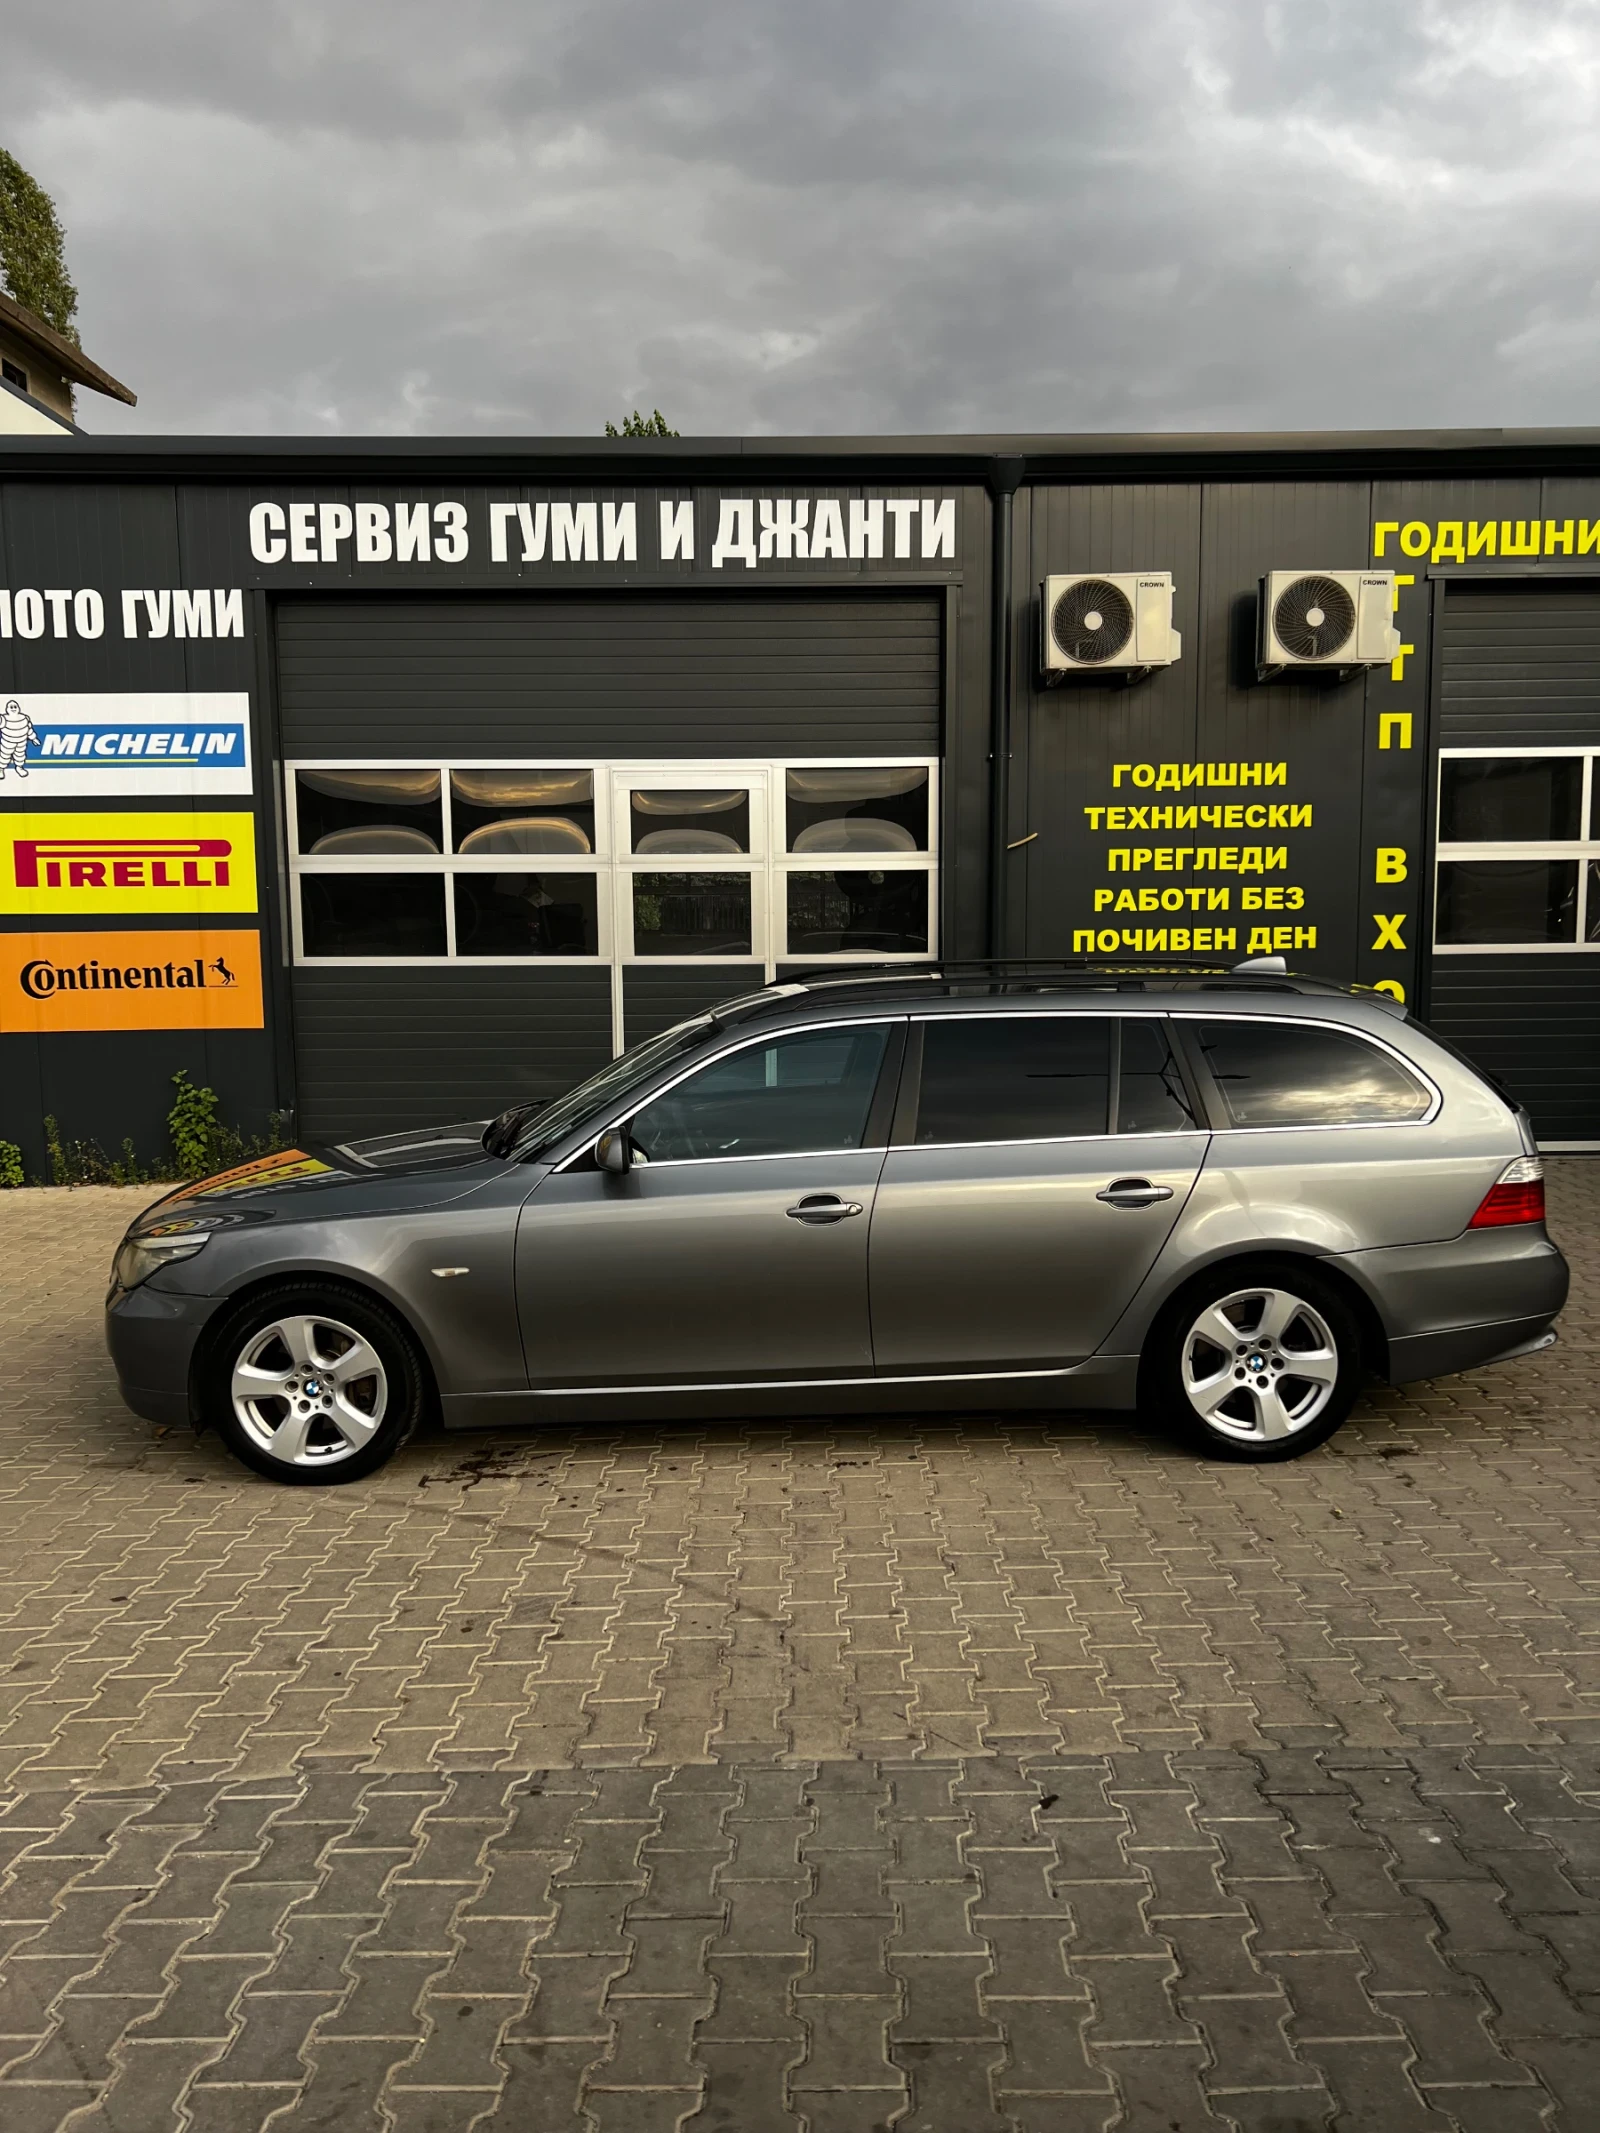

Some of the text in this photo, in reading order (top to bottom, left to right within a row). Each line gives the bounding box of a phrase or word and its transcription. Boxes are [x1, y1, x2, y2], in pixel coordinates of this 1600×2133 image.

[249, 498, 956, 569] СЕРВИЗ ГУМИ И ДЖАНТИ
[1373, 519, 1600, 564] ГОДИШНИ
[121, 588, 245, 639] ГУМИ
[40, 732, 237, 756] MICHELIN
[1112, 762, 1288, 792] ГОДИШНИ
[1083, 804, 1313, 830] ТЕХНИЧЕСКИ
[13, 839, 232, 888] PIRELLI
[1108, 846, 1288, 875] ПРЕГЛЕДИ
[1094, 886, 1305, 912] РАБОТИ БЕЗ
[1073, 926, 1317, 955] ПОЧИВЕН ДЕН
[20, 957, 207, 1000] Continental
